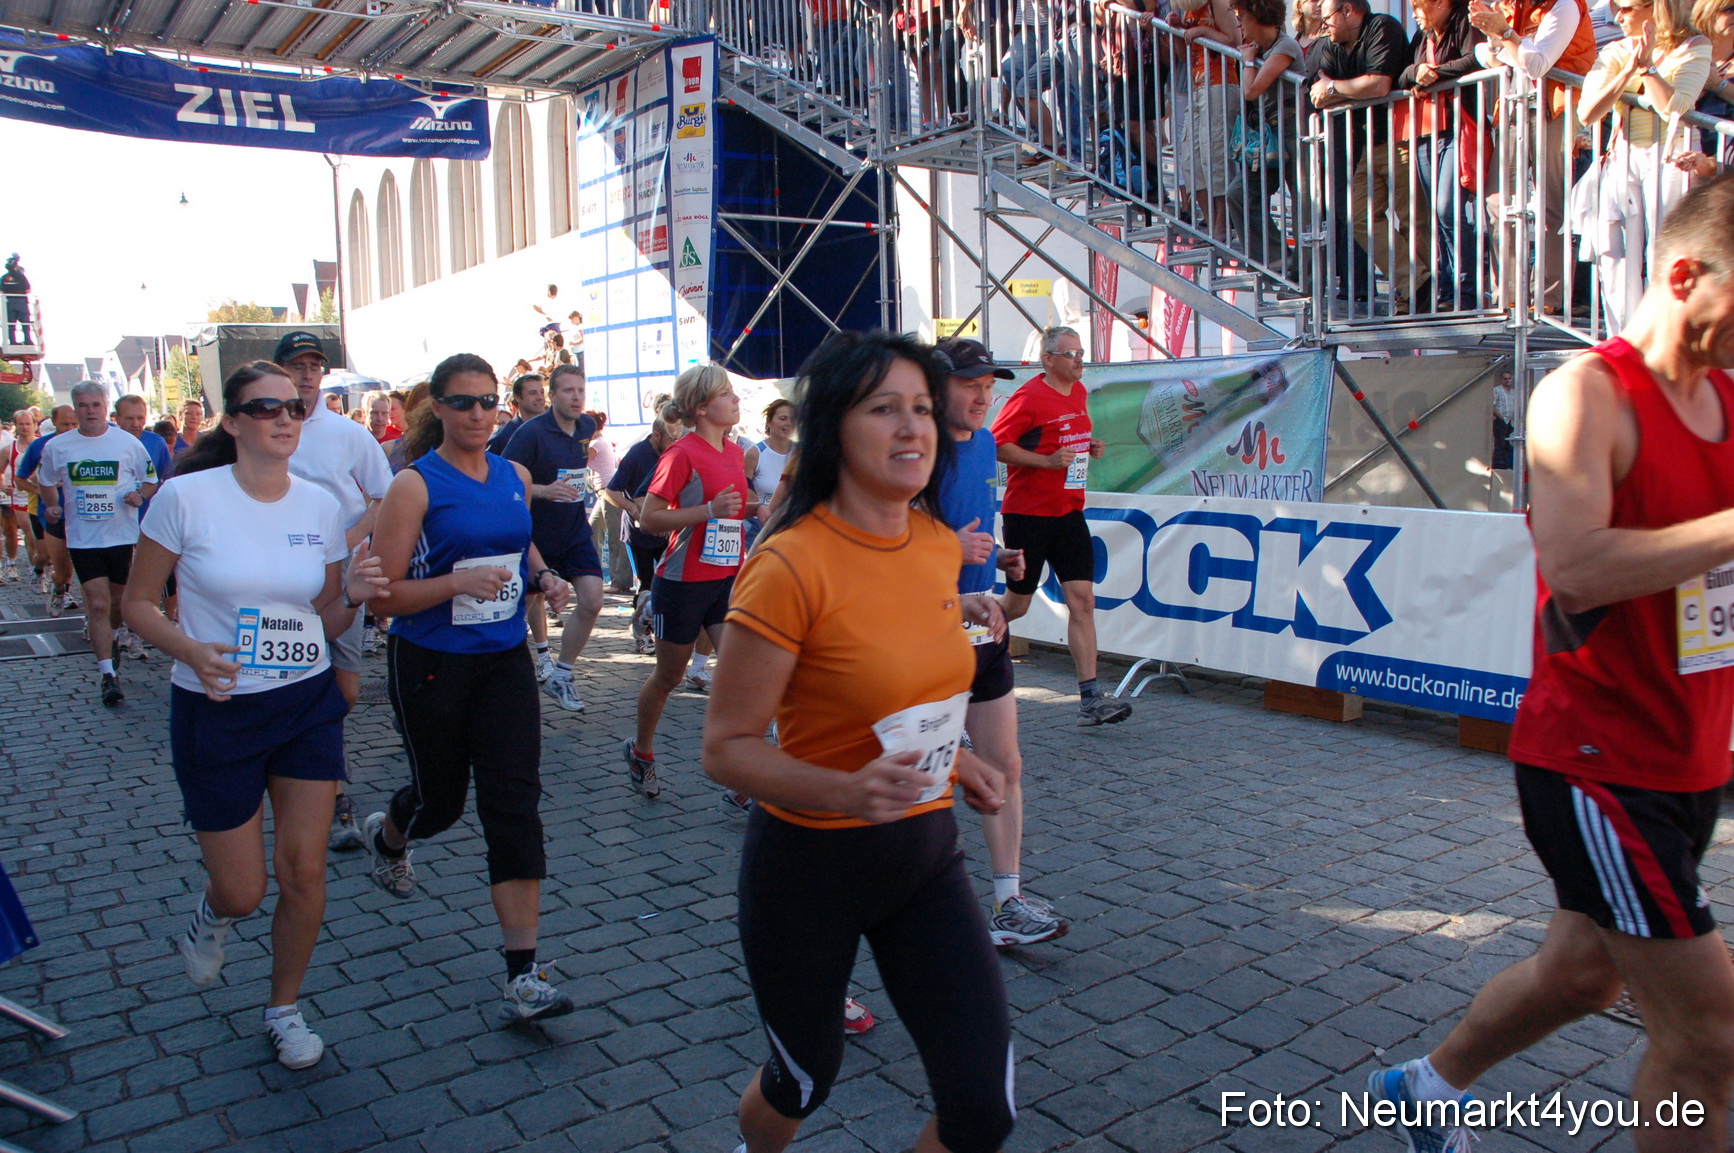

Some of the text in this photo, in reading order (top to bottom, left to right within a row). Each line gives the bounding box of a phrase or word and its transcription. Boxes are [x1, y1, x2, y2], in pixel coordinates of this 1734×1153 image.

[174, 83, 315, 133] ZIEL
[80, 466, 115, 477] GALERIA
[1191, 469, 1313, 502] NEUMARKTER
[87, 502, 114, 512] 2855
[717, 539, 739, 553] 3071
[994, 508, 1402, 646] OCK
[1684, 604, 1699, 621] C
[261, 617, 304, 632] Natalie
[242, 635, 252, 646] D
[261, 640, 320, 663] 3389
